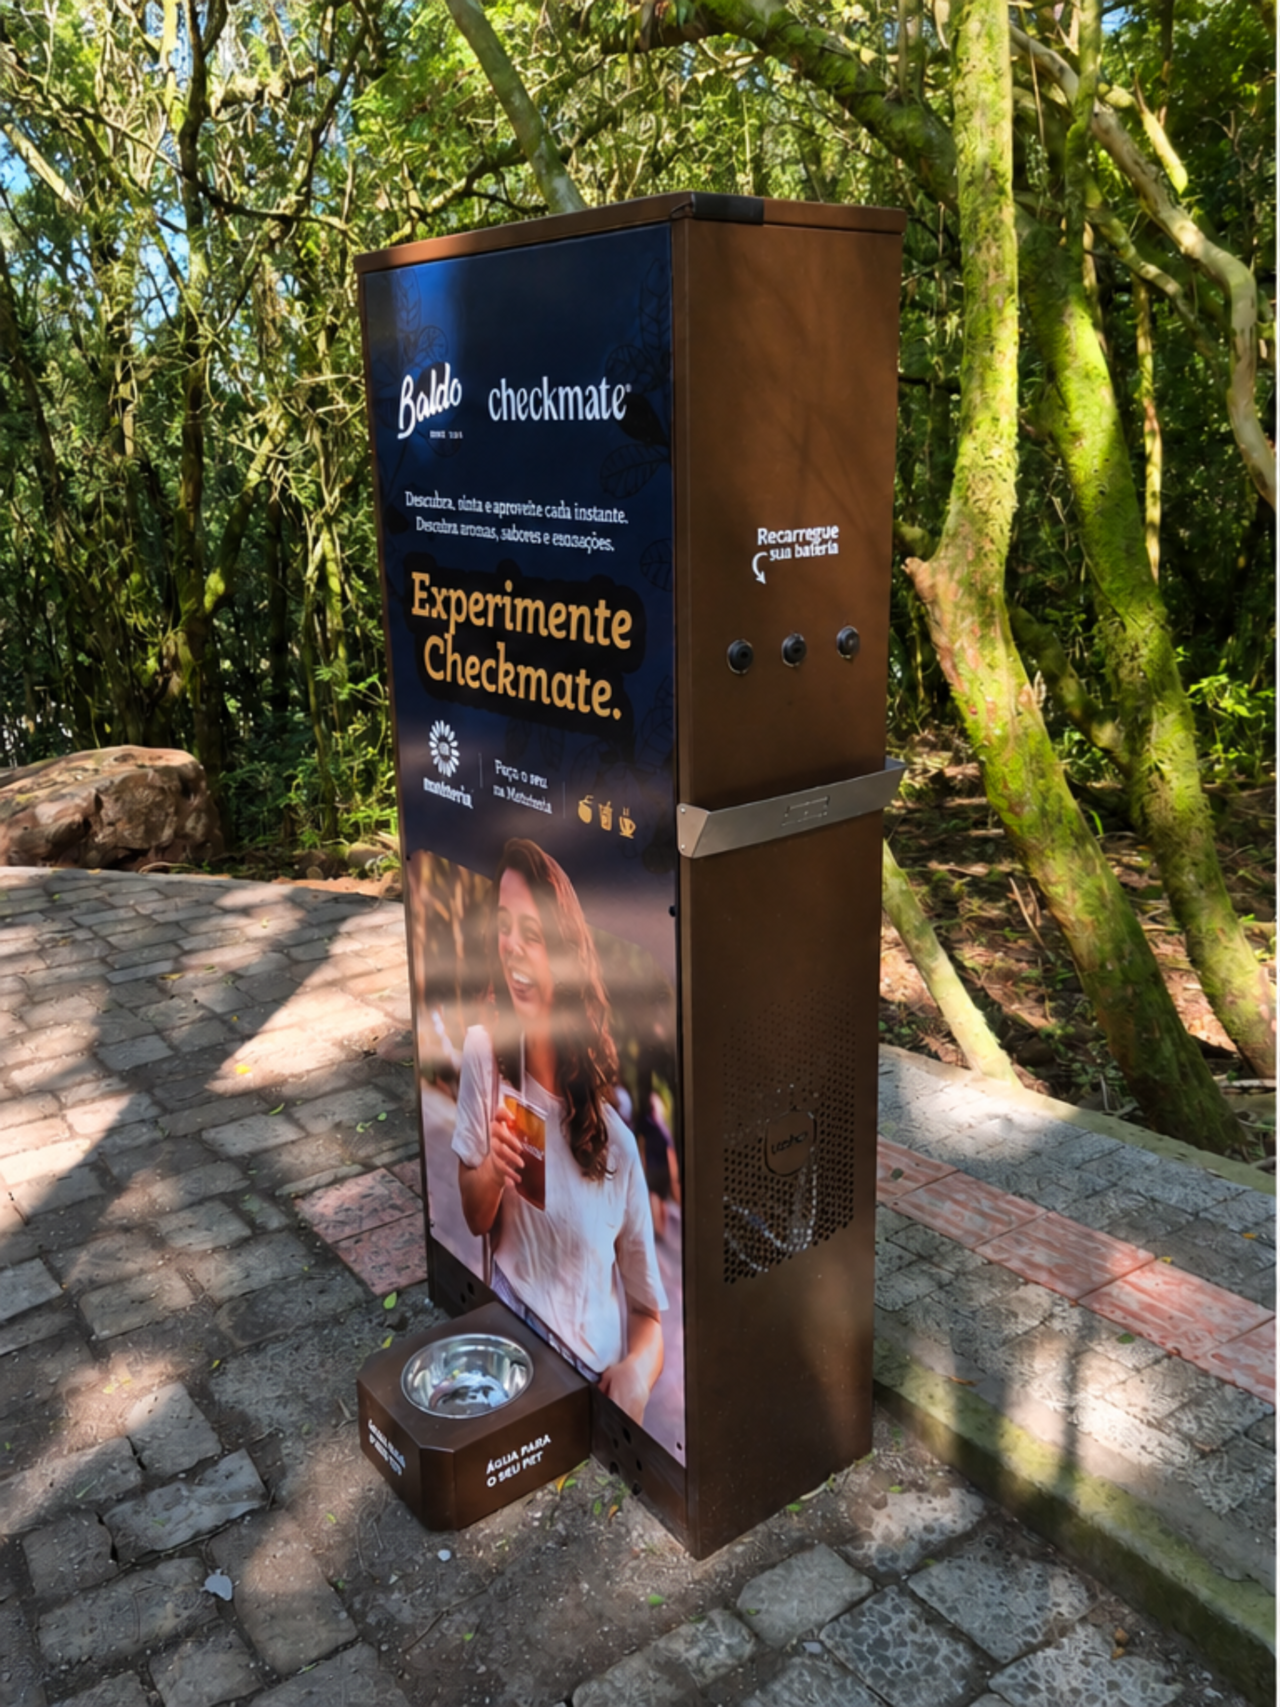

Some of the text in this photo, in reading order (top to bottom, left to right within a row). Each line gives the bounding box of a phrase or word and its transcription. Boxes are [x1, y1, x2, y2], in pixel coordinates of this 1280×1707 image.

[397, 362, 462, 439] Baldo
[488, 376, 628, 421] checkmate
[484, 501, 493, 513] e
[544, 500, 572, 519] cada
[542, 532, 551, 545] e
[757, 525, 840, 546] Recarregue
[411, 571, 633, 650] Experimente
[424, 632, 622, 720] Checkmate.
[486, 1476, 497, 1487] O
